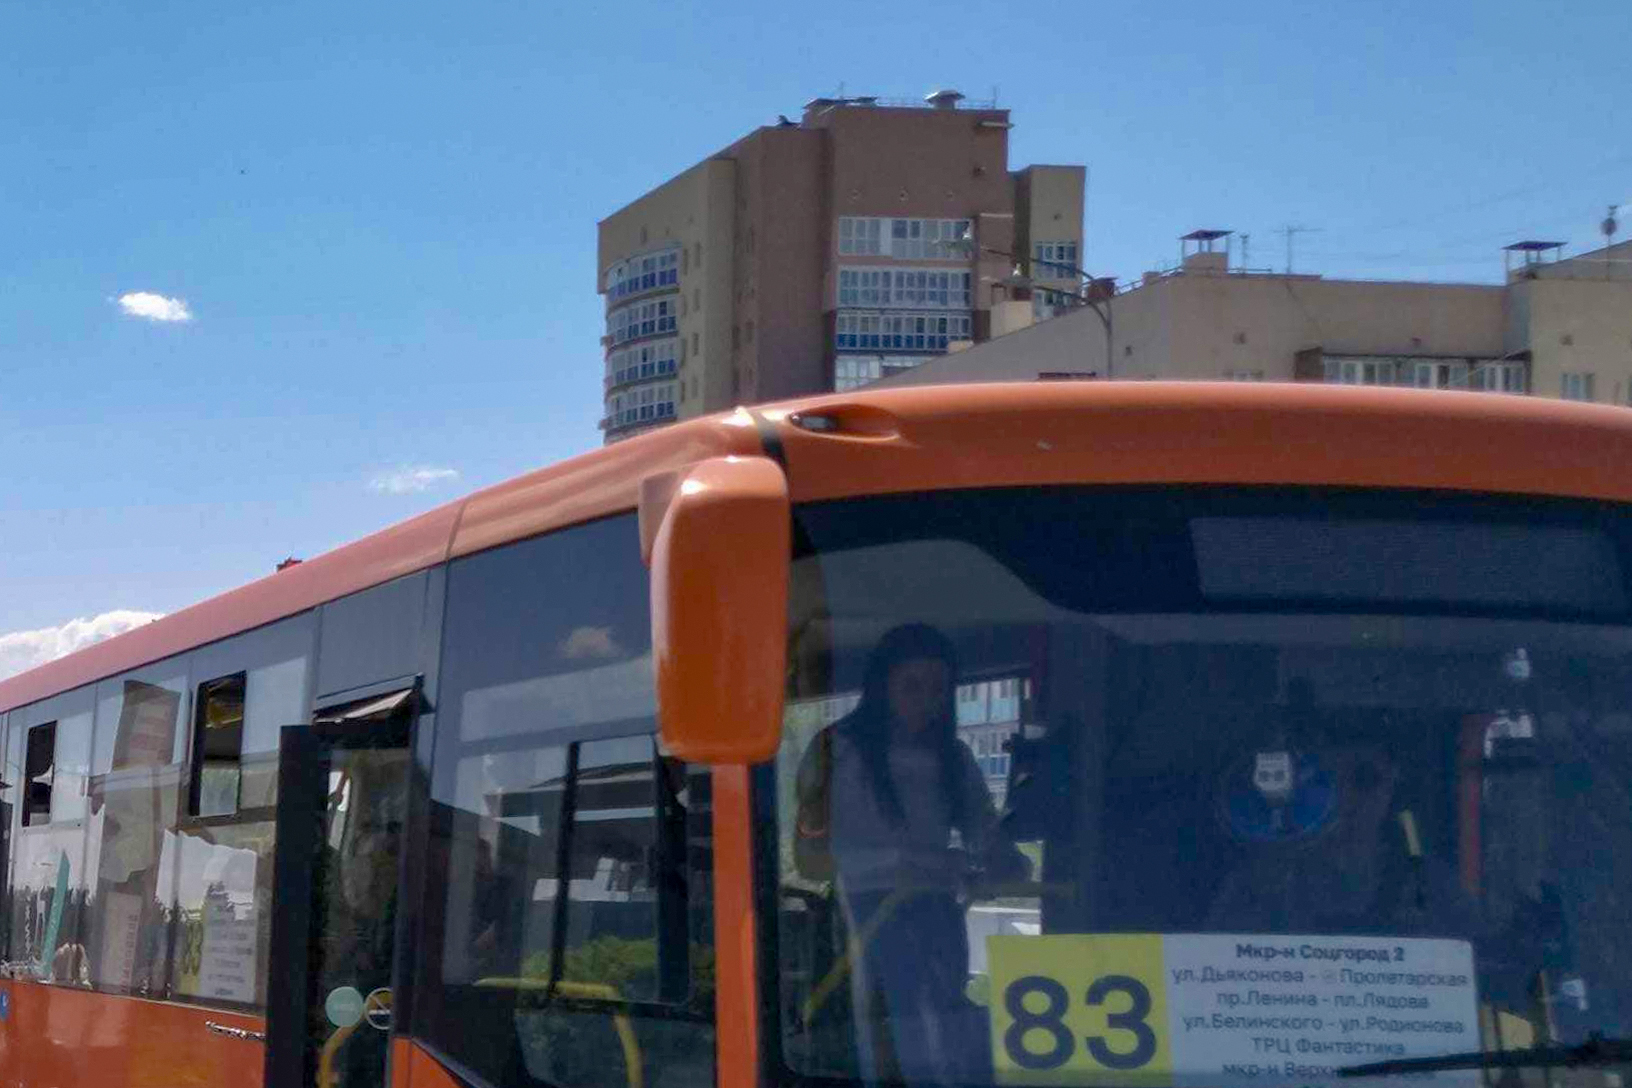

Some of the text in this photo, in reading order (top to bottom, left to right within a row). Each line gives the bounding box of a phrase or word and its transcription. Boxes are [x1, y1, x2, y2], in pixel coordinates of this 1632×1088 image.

[1236, 943, 1405, 963] Мкр-н Соцгород 2
[1005, 974, 1156, 1070] 83
[1253, 1037, 1405, 1055] ТРЦ Фантастика
